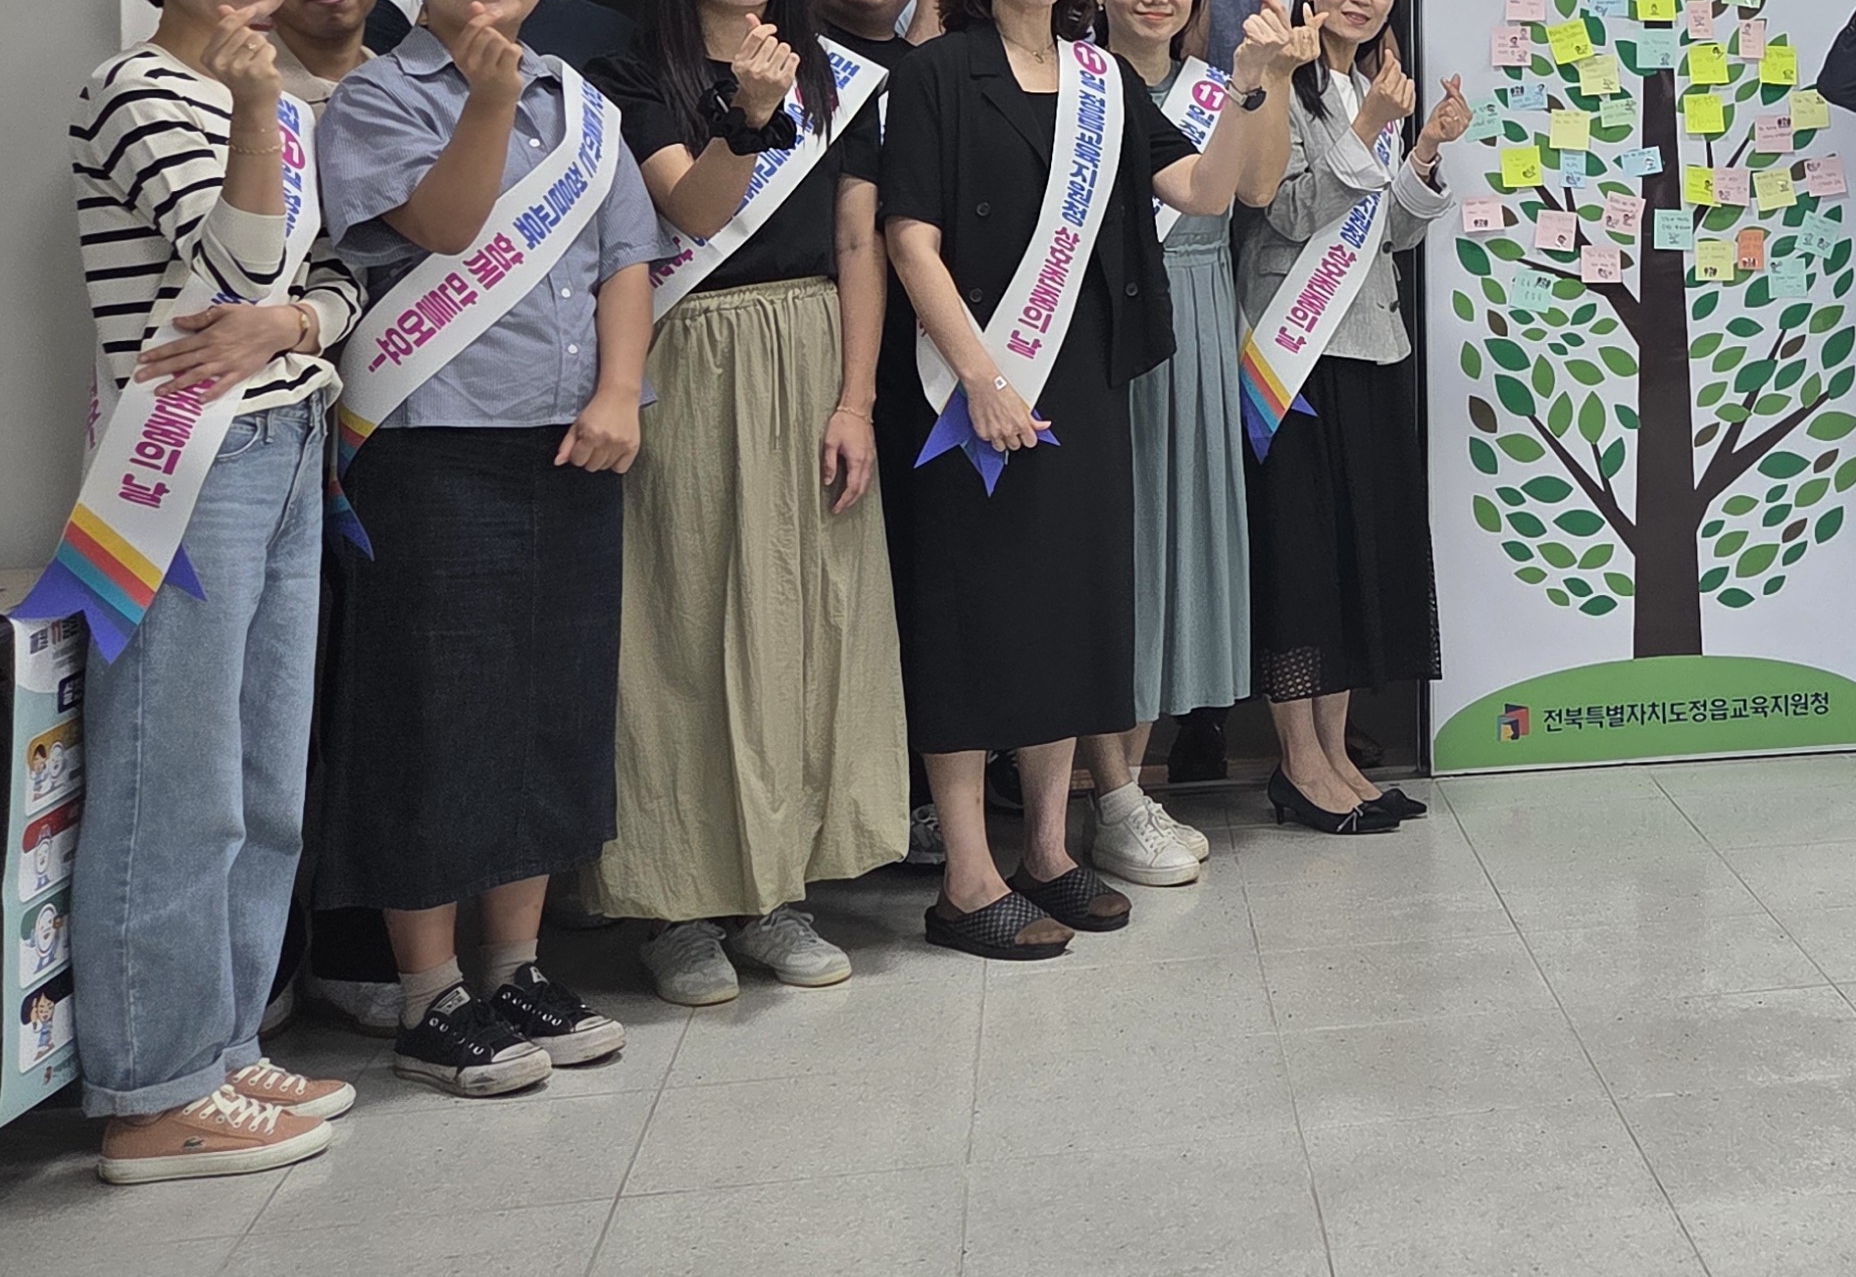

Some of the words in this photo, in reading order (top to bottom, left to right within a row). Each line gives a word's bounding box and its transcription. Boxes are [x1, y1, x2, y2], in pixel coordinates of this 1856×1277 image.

[1061, 89, 1108, 228] 정읍교육지원청
[513, 161, 589, 250] 정읍교육
[463, 232, 524, 291] 함께
[1018, 227, 1081, 334] 상호존중의
[1285, 243, 1357, 334] 상호존중의
[367, 272, 479, 373] 만들어요!
[1006, 330, 1044, 360] 날
[1275, 327, 1307, 354] 날
[118, 473, 170, 509] 날
